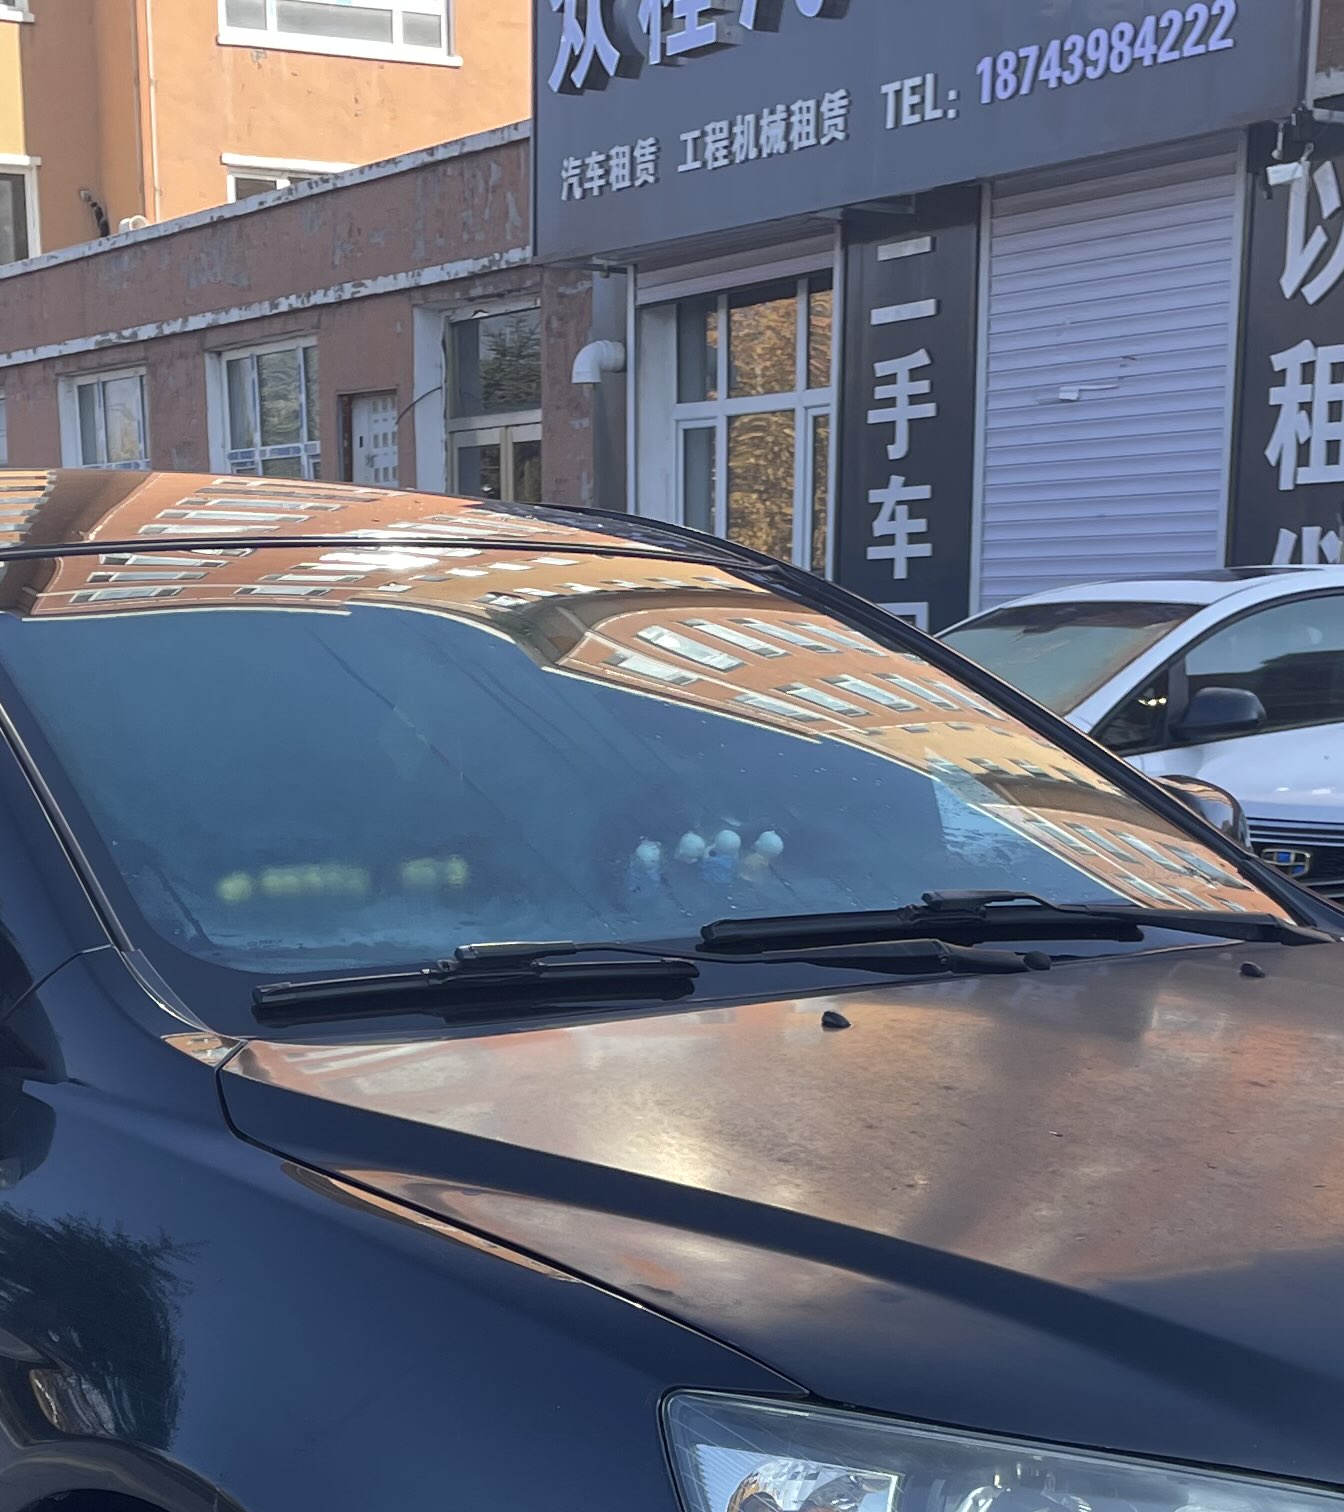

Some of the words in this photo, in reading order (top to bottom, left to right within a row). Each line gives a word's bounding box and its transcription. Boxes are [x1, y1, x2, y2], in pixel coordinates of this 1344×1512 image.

[561, 137, 658, 200] 汽车租赁
[677, 89, 850, 172] 工程机械租赁
[880, 73, 957, 129] TEL:
[976, 0, 1237, 104] 18743984222
